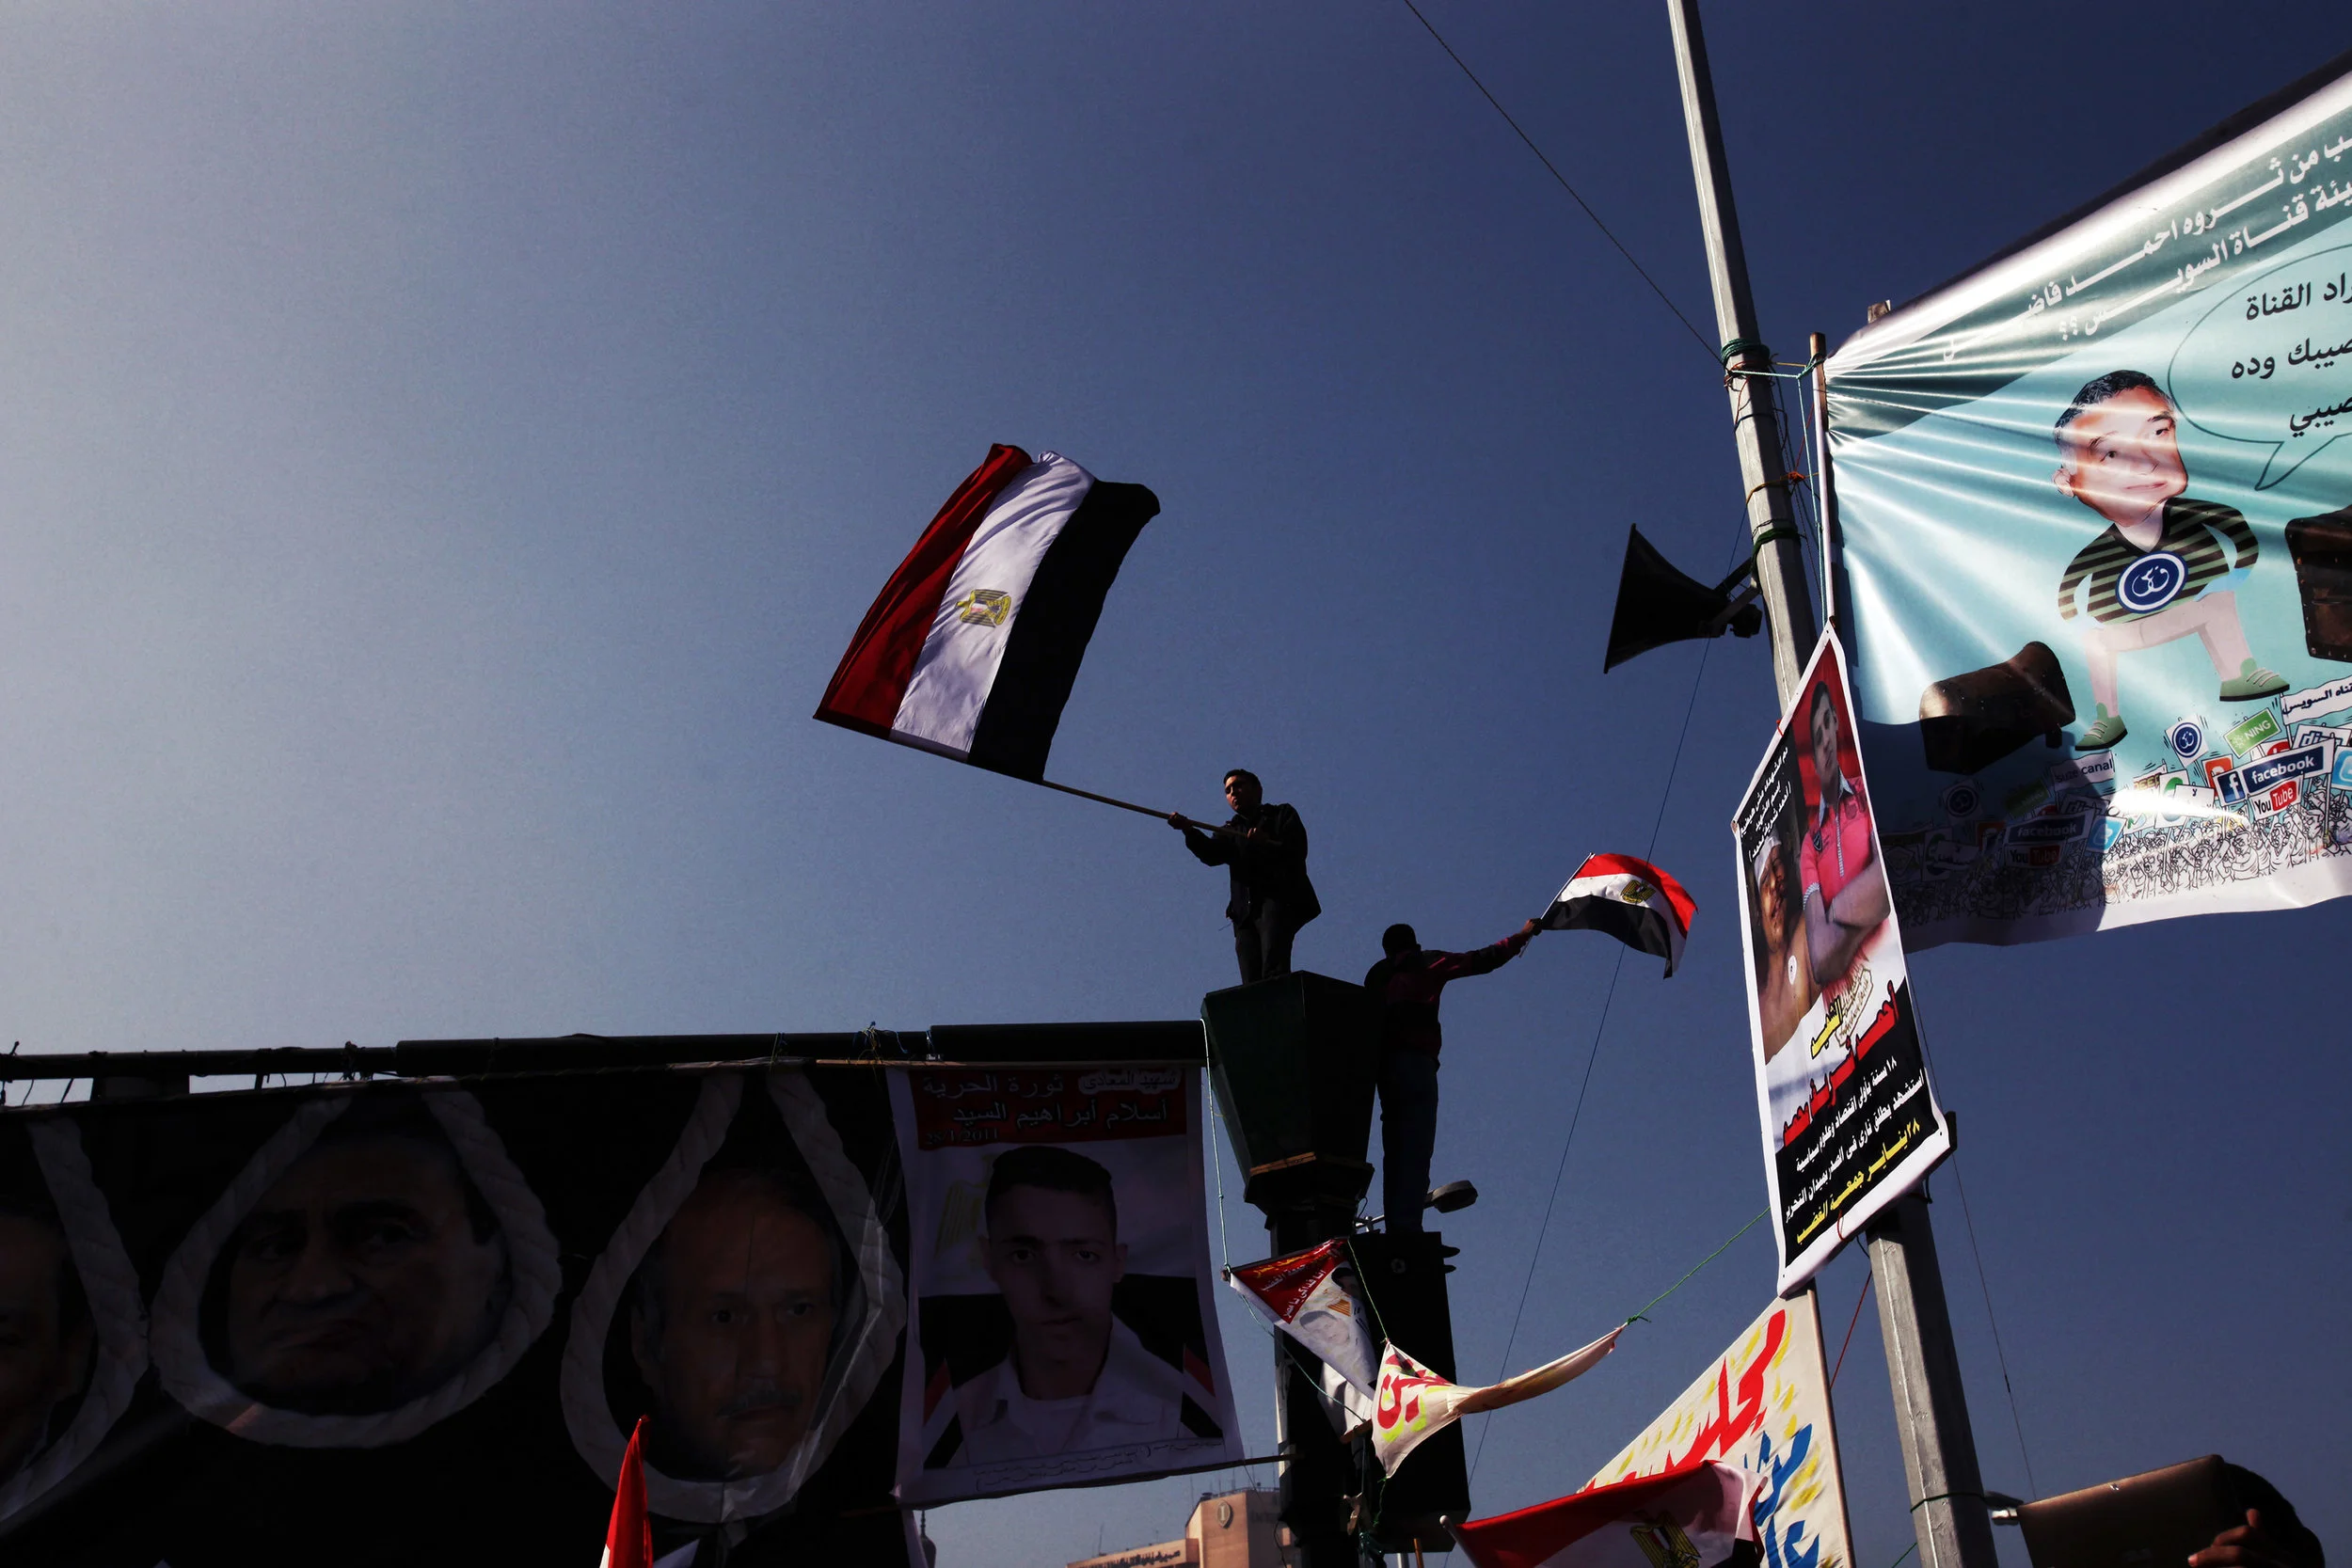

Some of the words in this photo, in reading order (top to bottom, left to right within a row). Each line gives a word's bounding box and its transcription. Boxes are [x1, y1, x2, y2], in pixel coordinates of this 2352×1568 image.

[2289, 150, 2319, 184] من
[2183, 157, 2284, 235] ثروه
[2229, 193, 2309, 255] قناة
[2066, 218, 2179, 296] احمد
[2085, 238, 2229, 336] السويس
[2246, 281, 2312, 321] القناة
[1943, 280, 2062, 363] فاضل
[2232, 356, 2276, 379] وده
[2244, 720, 2272, 740] NING
[2081, 759, 2114, 776] canal
[2251, 755, 2315, 785] facebook
[2017, 822, 2077, 837] facebook
[1810, 995, 1844, 1060] الشهيد
[923, 1073, 998, 1099] الحرية
[1009, 1072, 1064, 1099] ثورة
[1871, 1067, 1888, 1085] سنة
[1892, 1069, 1925, 1112] استشهد
[953, 1101, 1007, 1126] السيد
[1783, 1101, 1811, 1148] محمد
[1835, 1094, 1858, 1130] اقتصاد
[1873, 1102, 1893, 1133] بطلق
[1820, 1119, 1836, 1153] وعلوم
[1796, 1144, 1820, 1173] سياسية
[1828, 1146, 1845, 1180] الصدر
[1867, 1129, 1908, 1182] يناير
[1808, 1167, 1829, 1202] بميدان
[1830, 1169, 1865, 1212] جمعة
[1786, 1187, 1807, 1224] التحرير
[1796, 1198, 1828, 1245] الغضب
